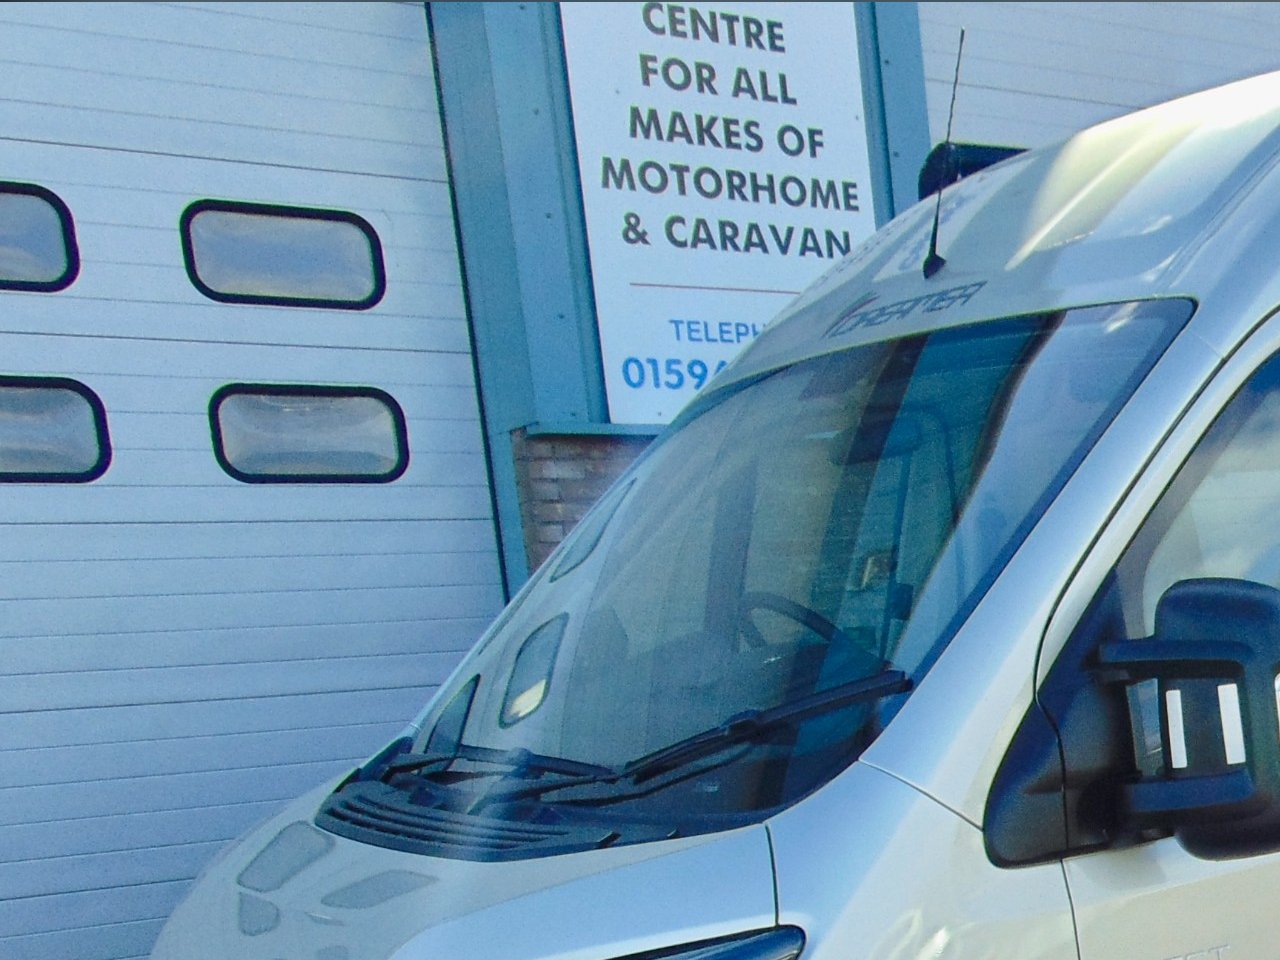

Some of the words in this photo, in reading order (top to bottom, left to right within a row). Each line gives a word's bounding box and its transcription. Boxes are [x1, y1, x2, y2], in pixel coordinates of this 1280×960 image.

[642, 2, 786, 53] CENTRE
[639, 53, 718, 95] FOR
[732, 66, 797, 105] ALL
[629, 106, 763, 152] MAKES
[777, 125, 824, 158] OF
[601, 156, 859, 212] MOTORHOME
[622, 211, 651, 246] &
[664, 214, 851, 259] CARAVAN
